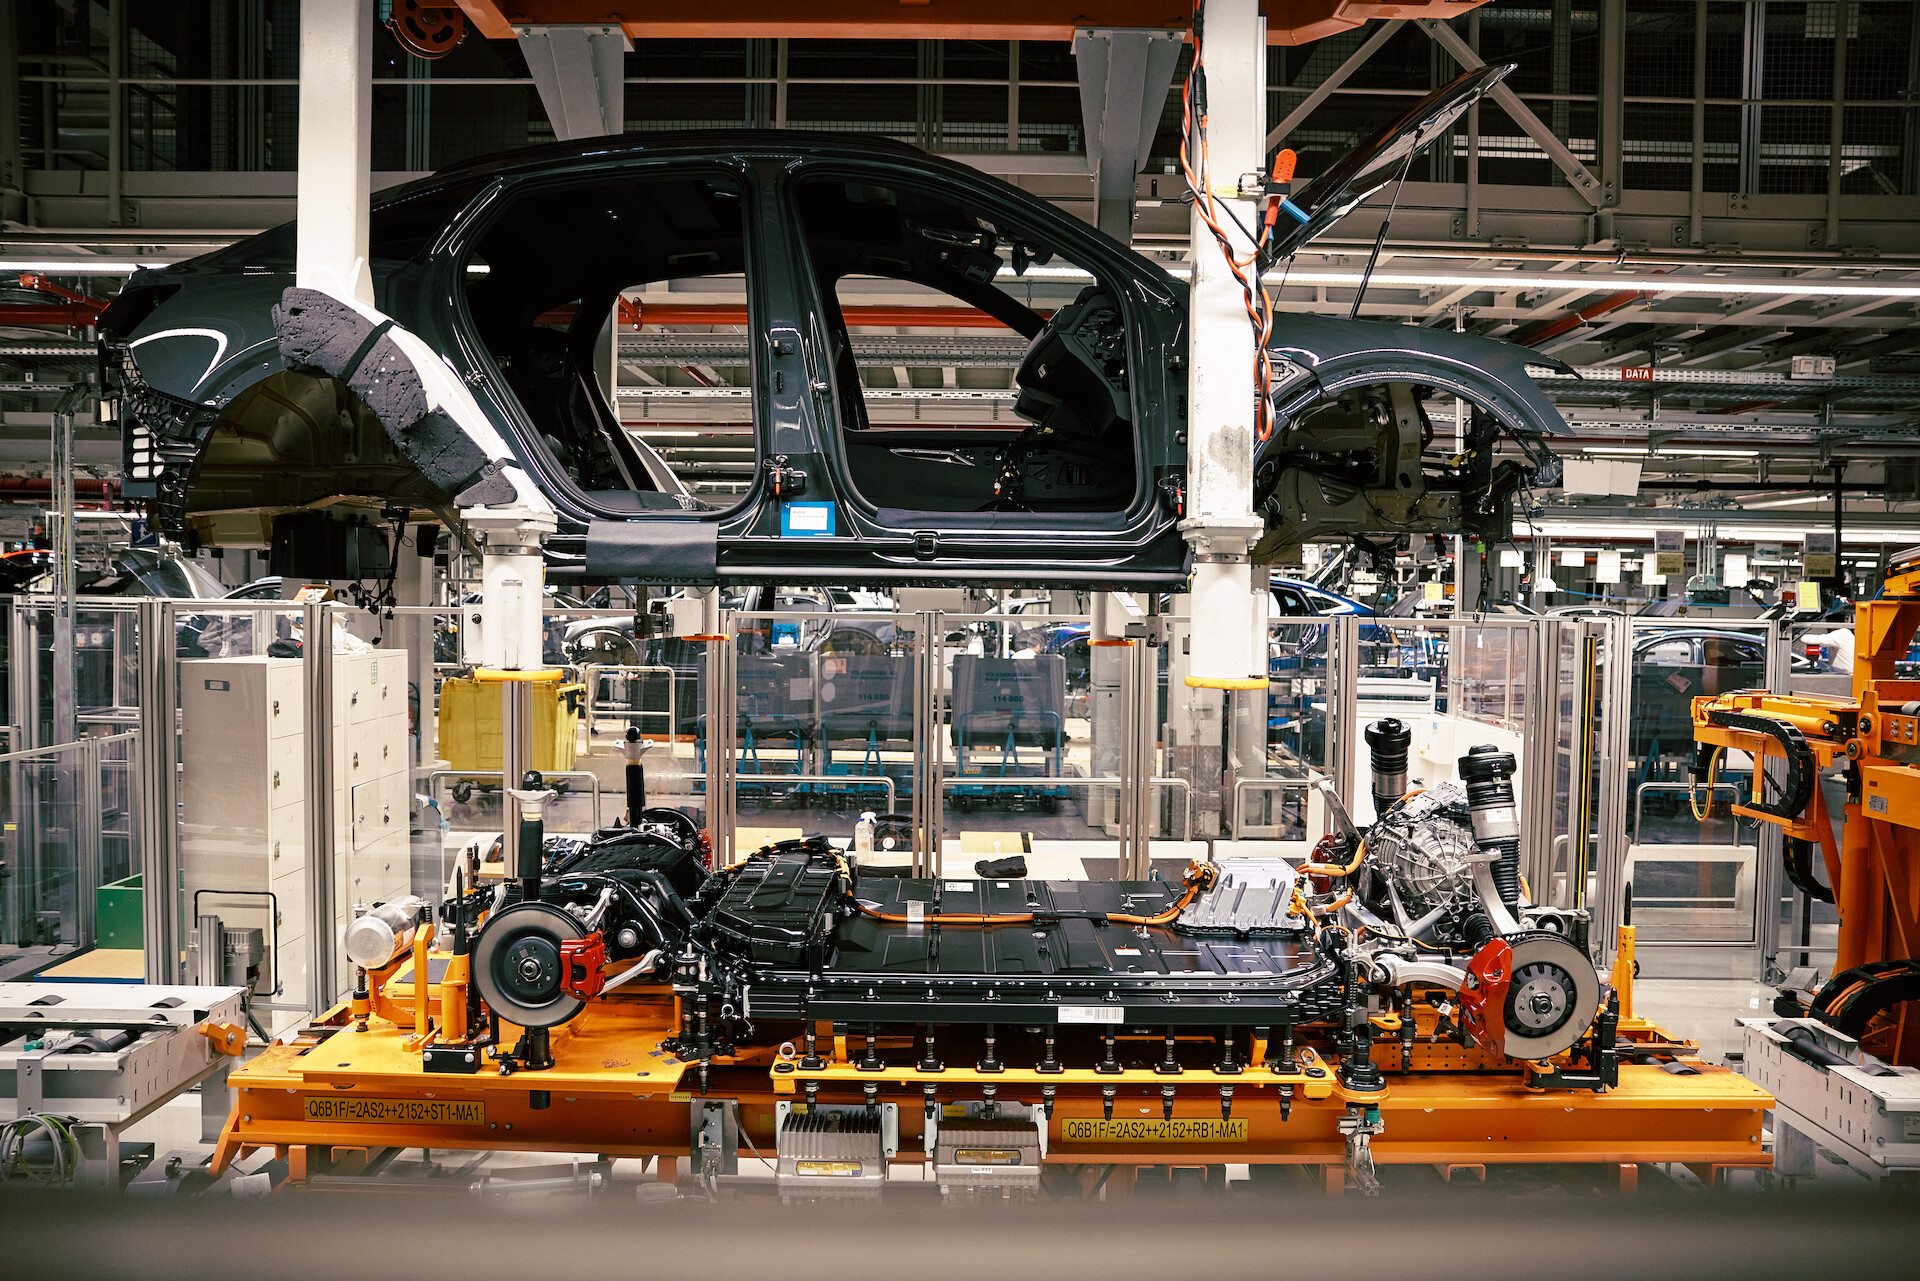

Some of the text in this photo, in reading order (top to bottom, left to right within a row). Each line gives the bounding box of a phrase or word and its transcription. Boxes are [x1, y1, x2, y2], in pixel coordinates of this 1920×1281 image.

[1625, 368, 1650, 380] DATA
[992, 695, 1007, 703] 114
[309, 1099, 479, 1121] Q6B1F/=2AS2++2152+ST1-MA1
[1068, 1121, 1243, 1138] Q6B1F/=2AS2++2152+RB1-MA1
